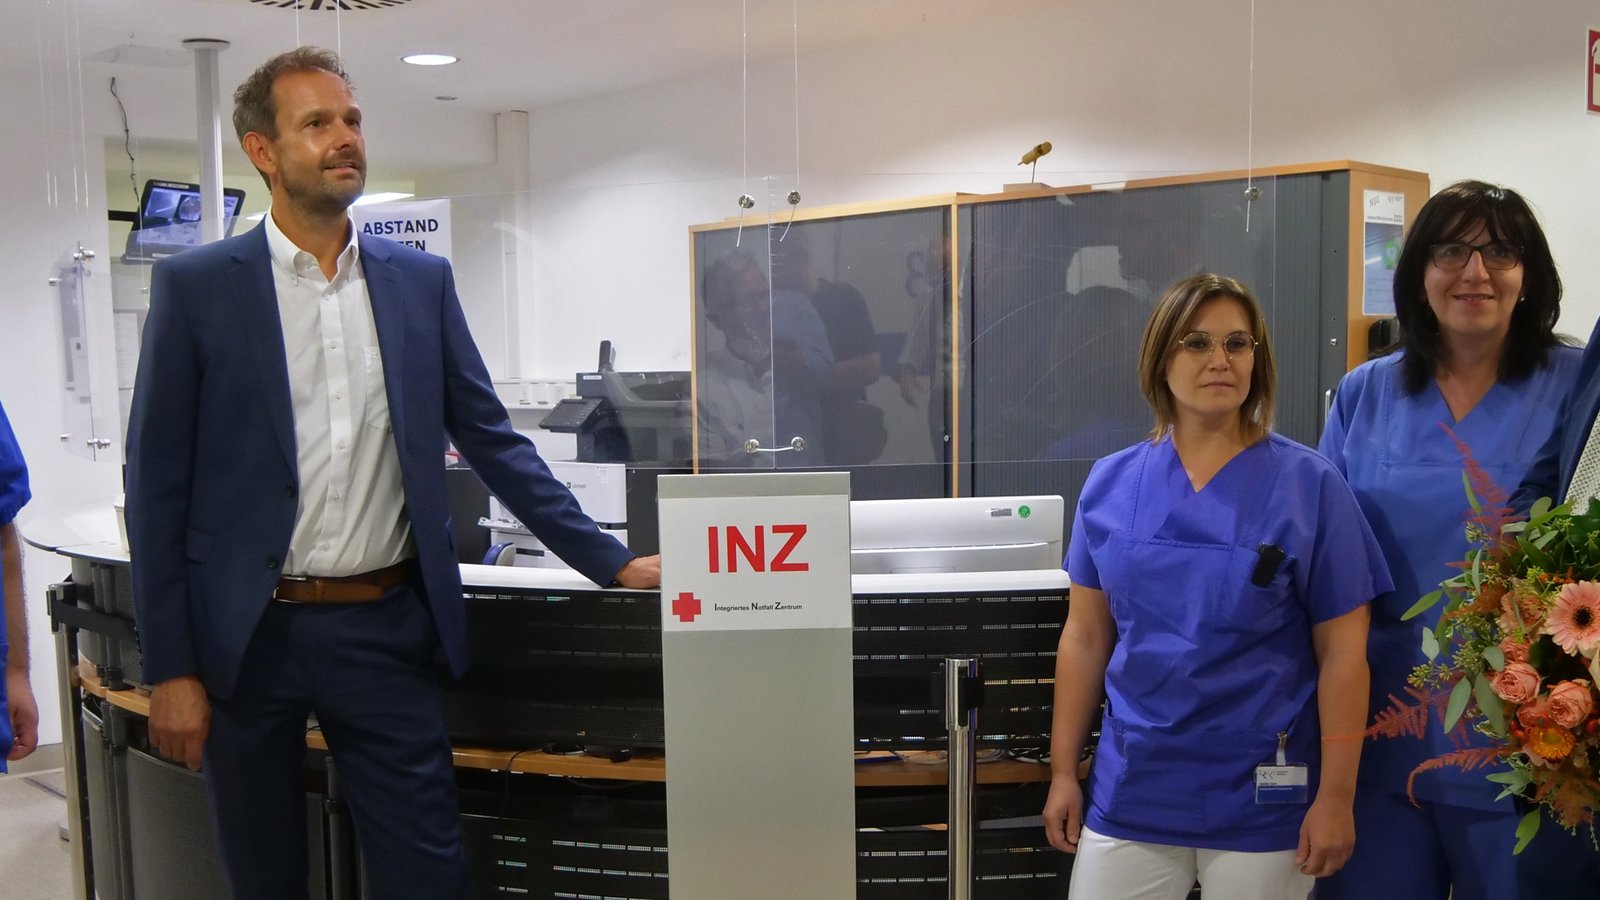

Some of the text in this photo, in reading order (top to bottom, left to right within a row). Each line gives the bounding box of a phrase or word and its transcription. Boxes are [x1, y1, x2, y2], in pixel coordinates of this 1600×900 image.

[363, 219, 439, 235] ABSTAND
[708, 524, 809, 573] INZ
[714, 602, 802, 612] Integriertes Notfall Zentrum
